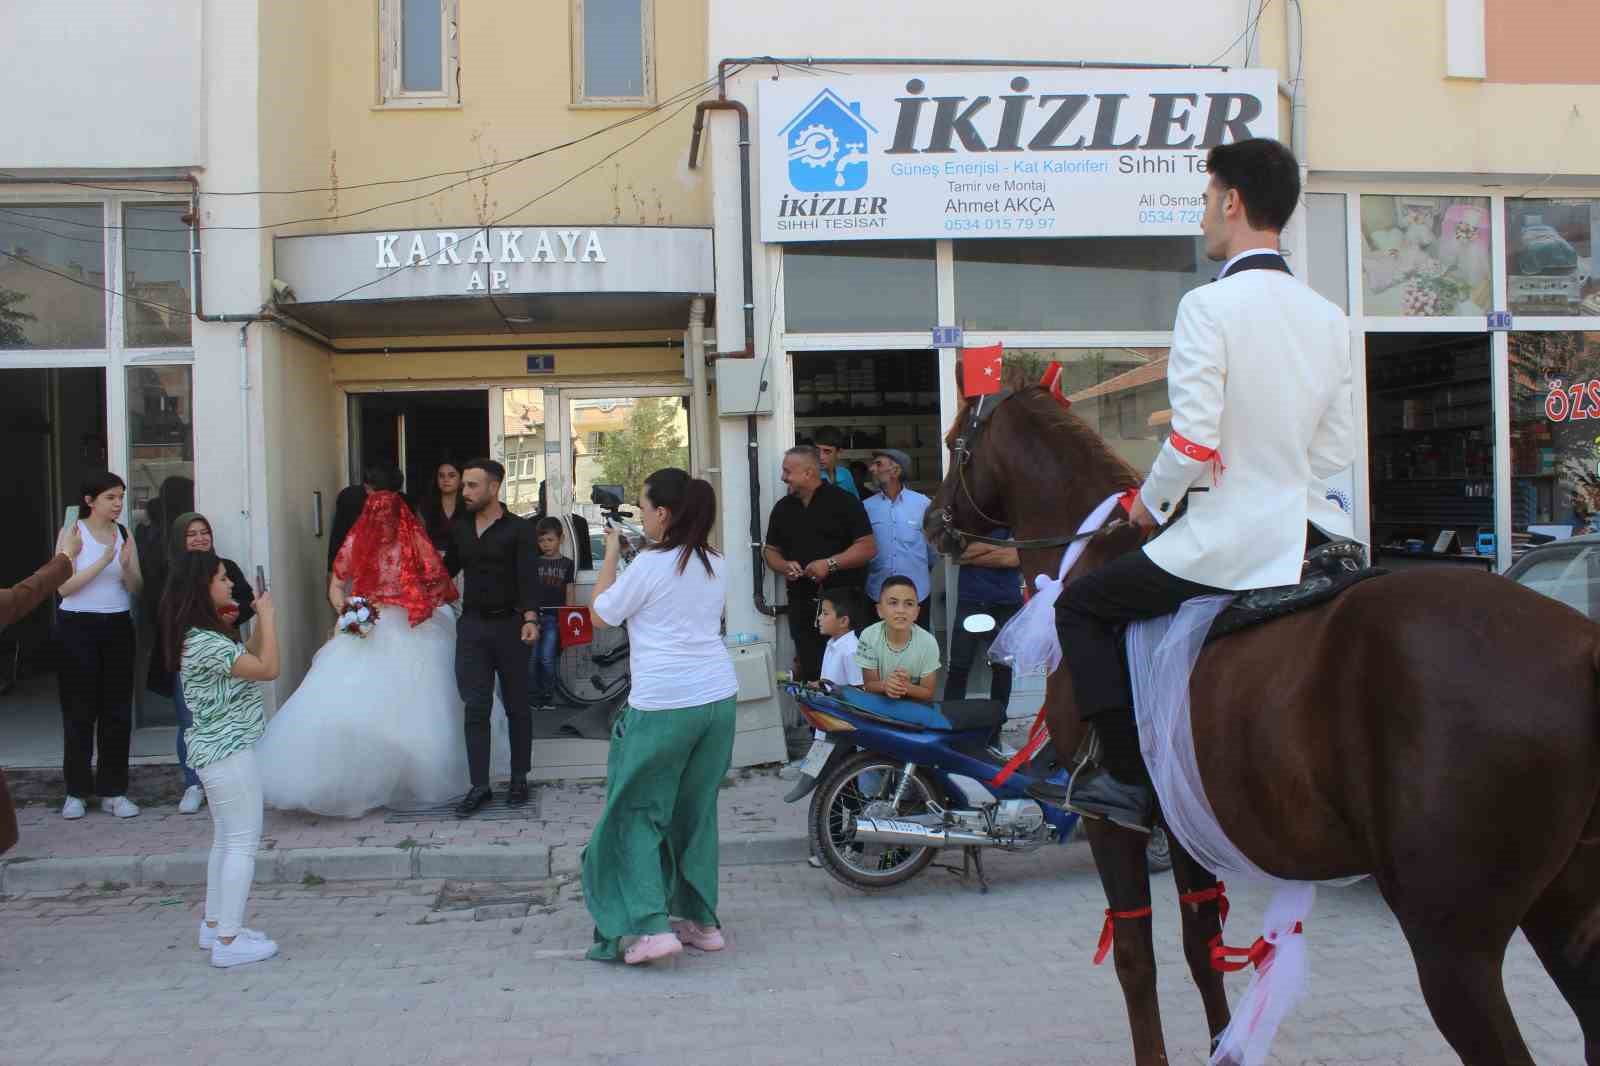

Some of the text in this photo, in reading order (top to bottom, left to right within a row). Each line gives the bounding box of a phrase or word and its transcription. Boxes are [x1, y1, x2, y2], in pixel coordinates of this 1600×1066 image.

[884, 77, 1263, 153] İKİZLER
[890, 161, 940, 178] Güneş
[944, 161, 999, 178] Enerjisi
[1014, 160, 1038, 174] Kat
[1043, 159, 1109, 174] Kaloriferi
[948, 180, 1046, 194] Tamir ve Montaj
[779, 193, 887, 217] İKİZLER
[944, 197, 1055, 215] Ahmet AKÇA
[1139, 193, 1154, 207] Ali
[944, 217, 1055, 232] 0534 015 79 97
[1139, 210, 1173, 224] 0534
[375, 230, 609, 269] KARAKAYA
